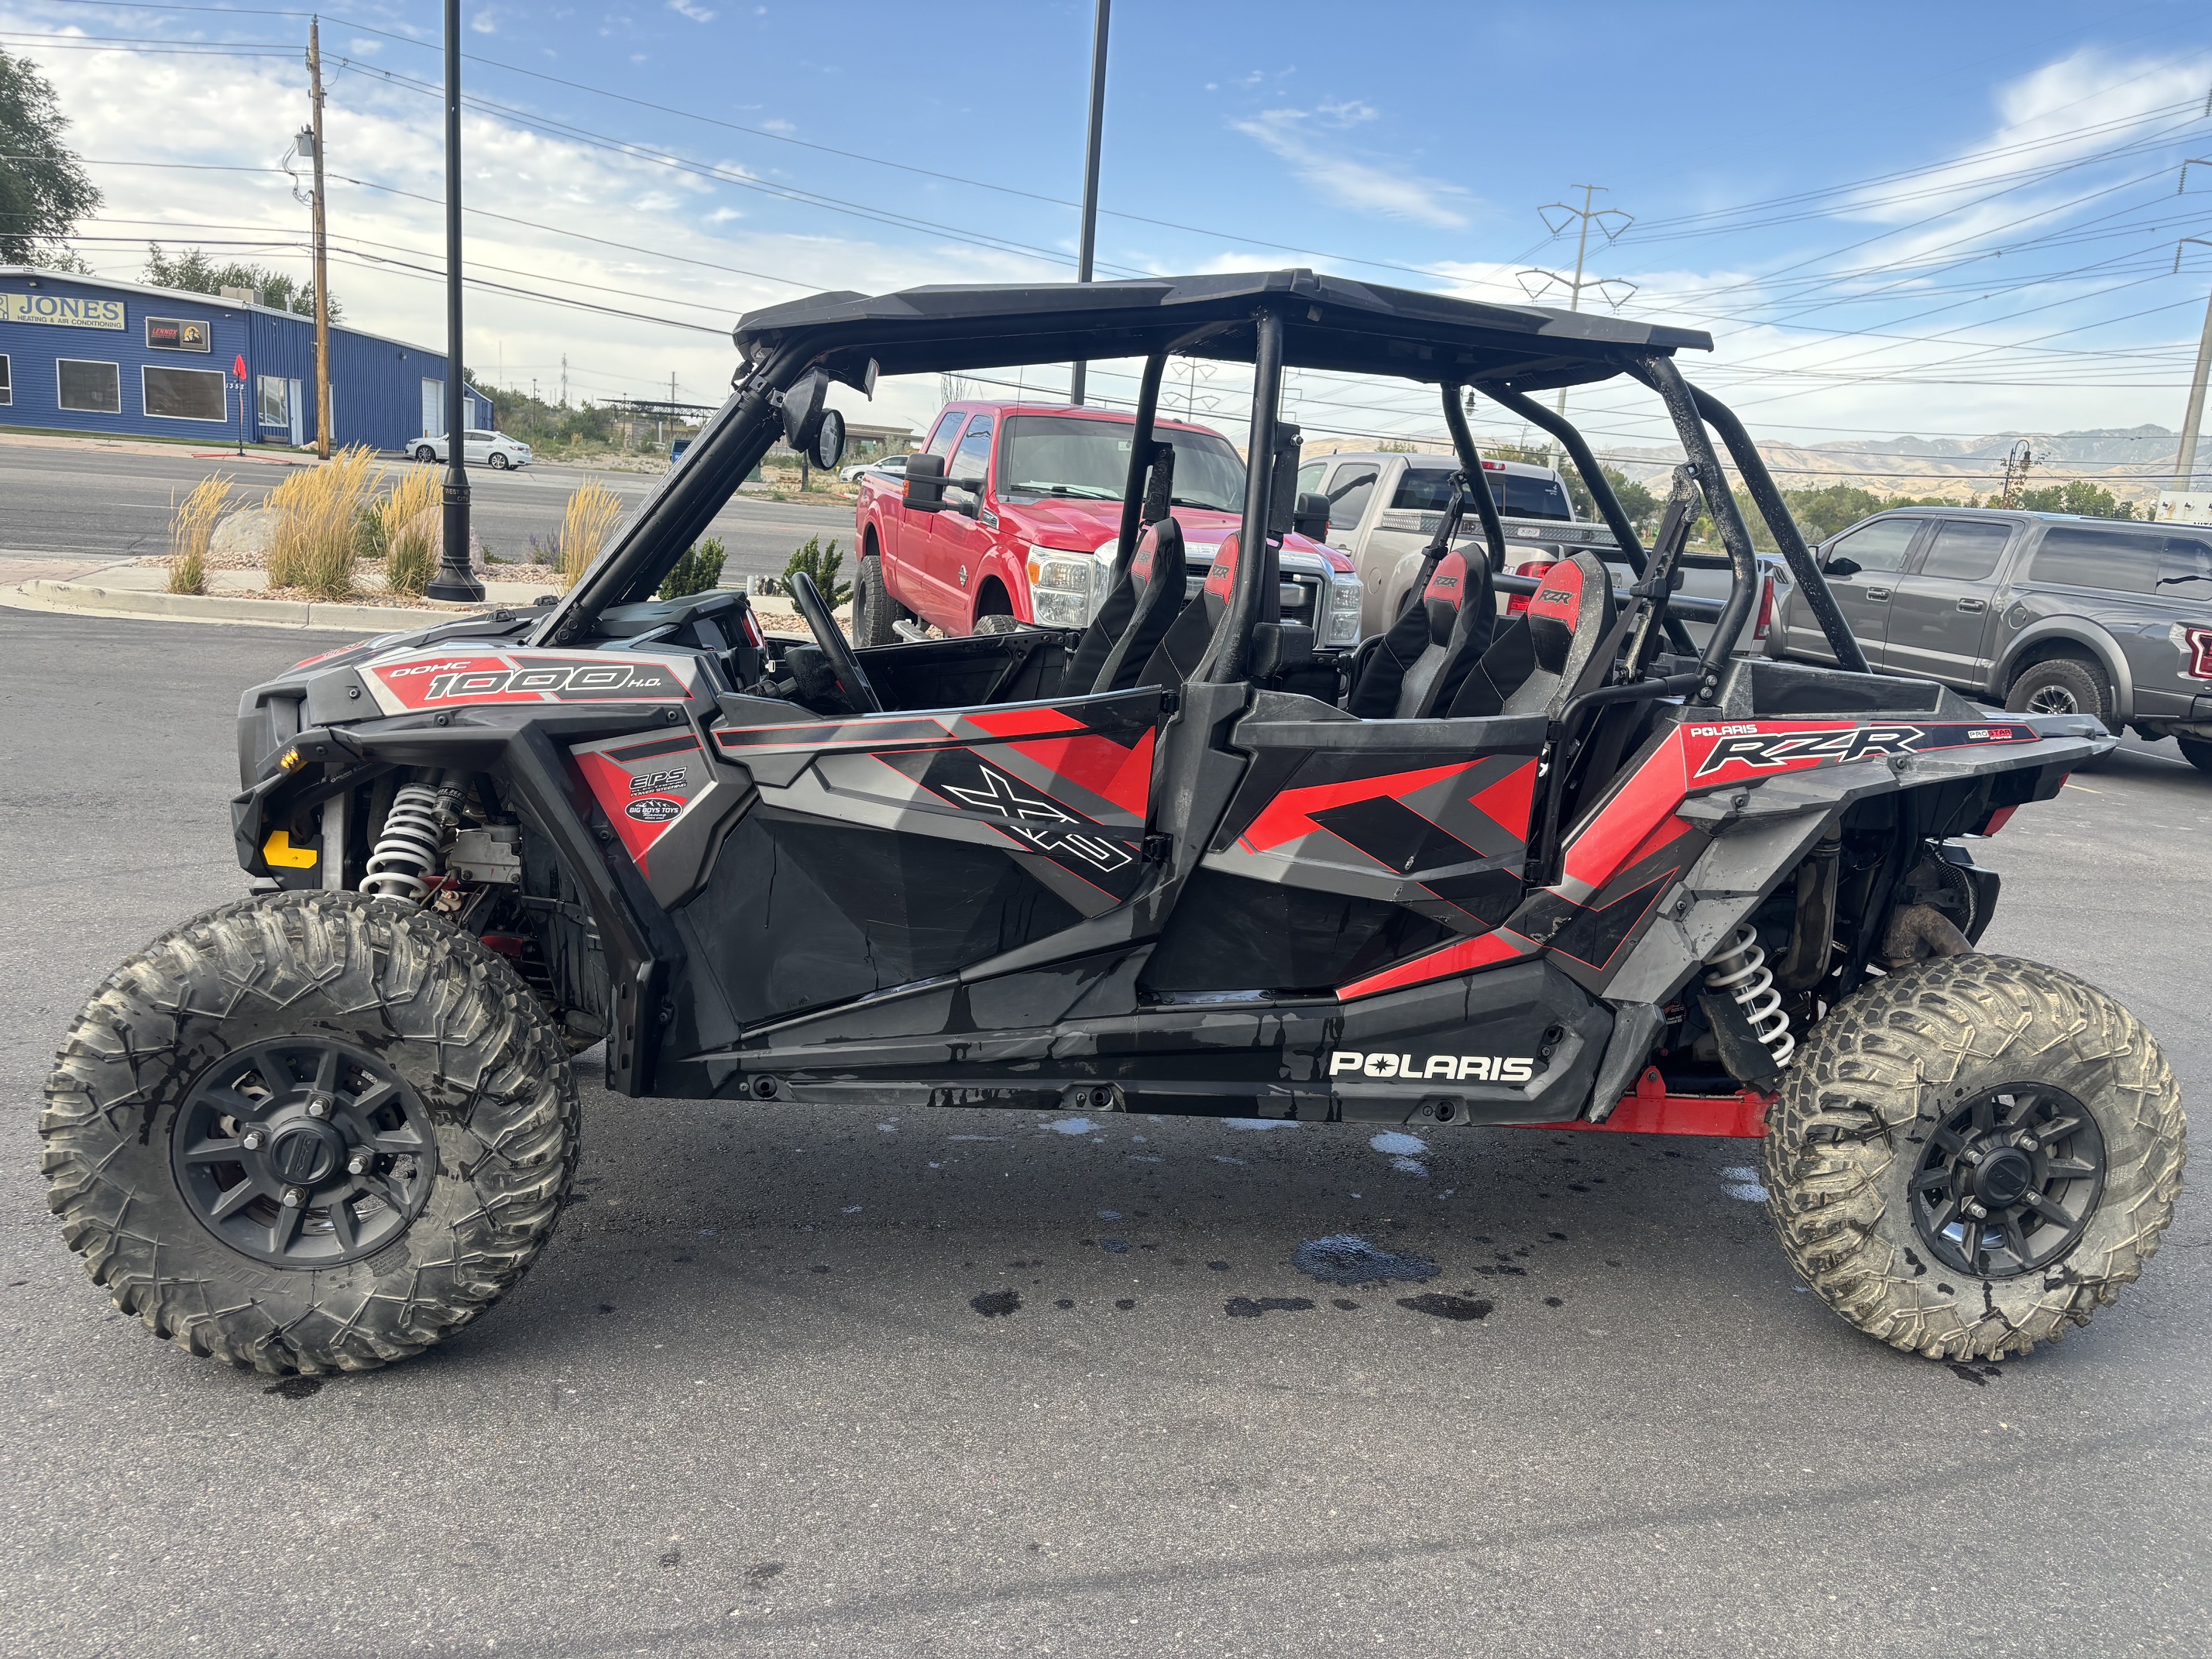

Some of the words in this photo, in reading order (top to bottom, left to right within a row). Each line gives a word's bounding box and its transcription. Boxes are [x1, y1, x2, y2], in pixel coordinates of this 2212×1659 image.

[19, 295, 119, 321] JONES
[17, 314, 47, 323] HEATING
[71, 318, 122, 328] CONDITIONING
[152, 327, 178, 336] LENNOX
[1211, 563, 1231, 581] RZR
[1432, 575, 1458, 589] RZR
[1537, 588, 1574, 606] RZR
[390, 661, 472, 678] DOHC
[423, 665, 634, 701] 1000
[627, 678, 662, 688] H.O.
[1690, 724, 1758, 737] POLARIS
[1692, 726, 1925, 779] RZR
[628, 766, 688, 790] EPS
[630, 789, 654, 798] POWER
[655, 782, 688, 792] STEERING
[1328, 1051, 1534, 1081] POLARIS
